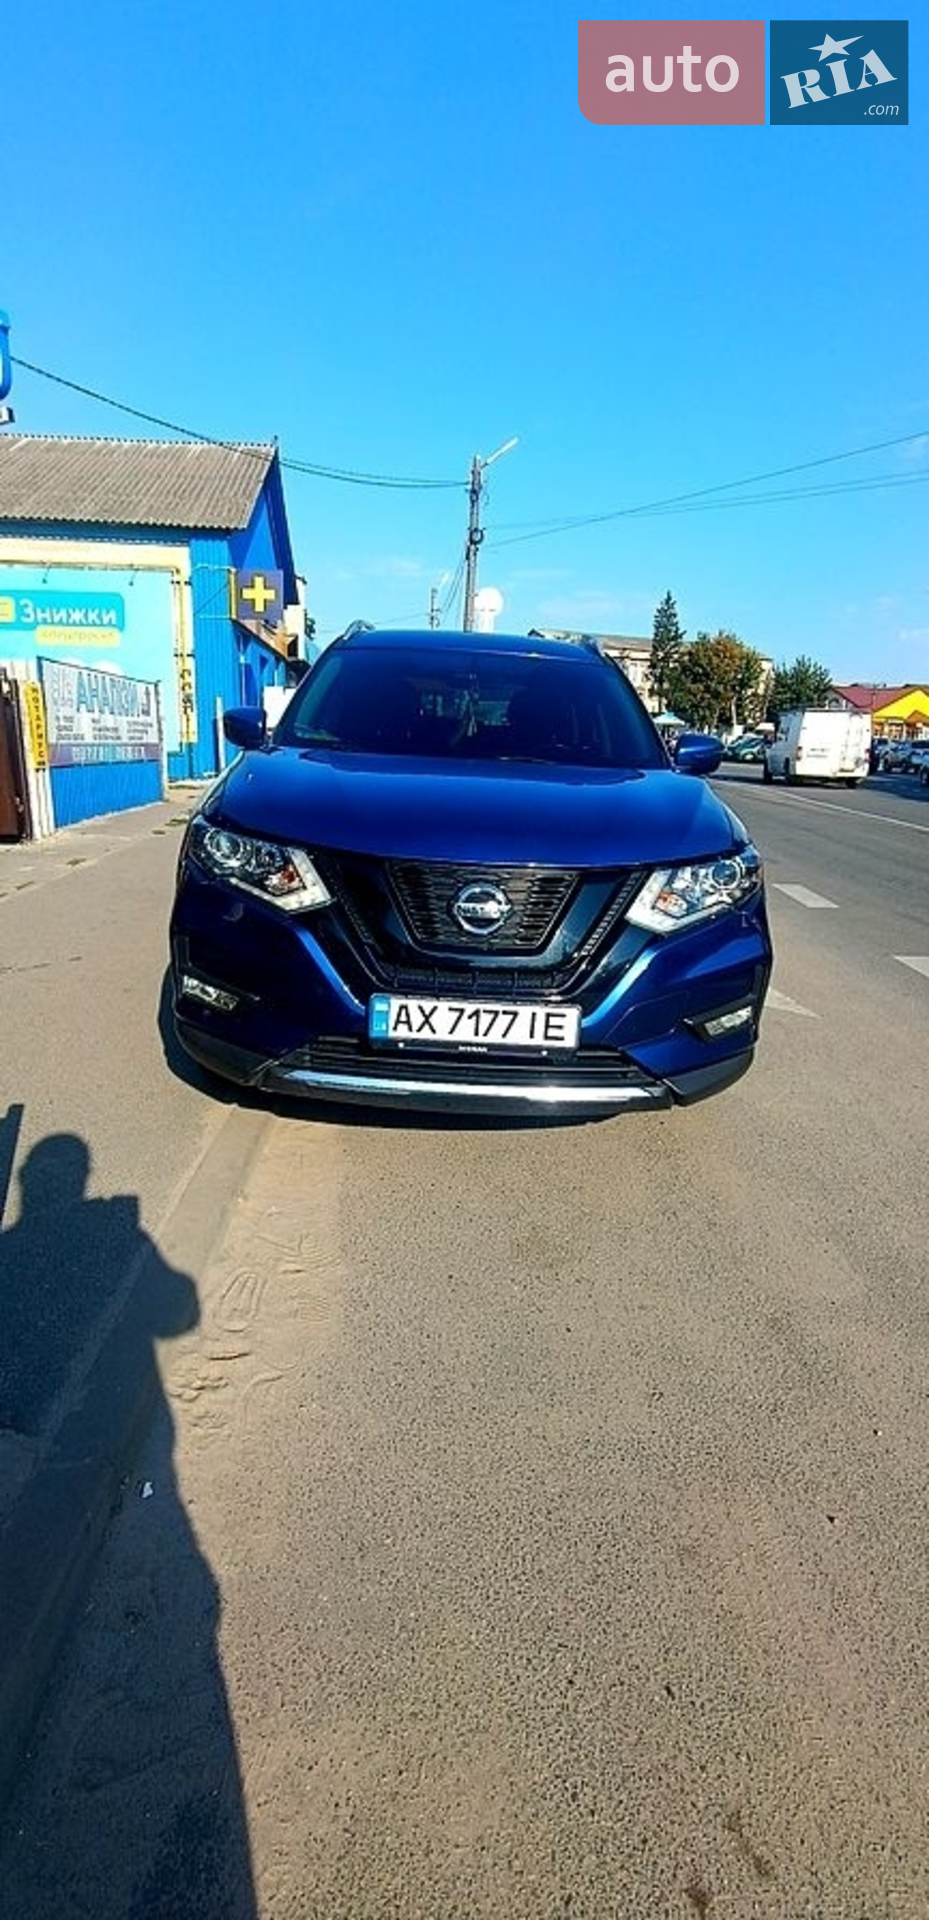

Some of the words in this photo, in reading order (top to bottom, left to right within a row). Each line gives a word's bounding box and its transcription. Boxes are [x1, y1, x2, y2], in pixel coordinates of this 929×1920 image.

[19, 598, 117, 626] Знижки
[392, 1003, 438, 1035] AX
[448, 1006, 519, 1039] 7177
[529, 1011, 567, 1041] IE
